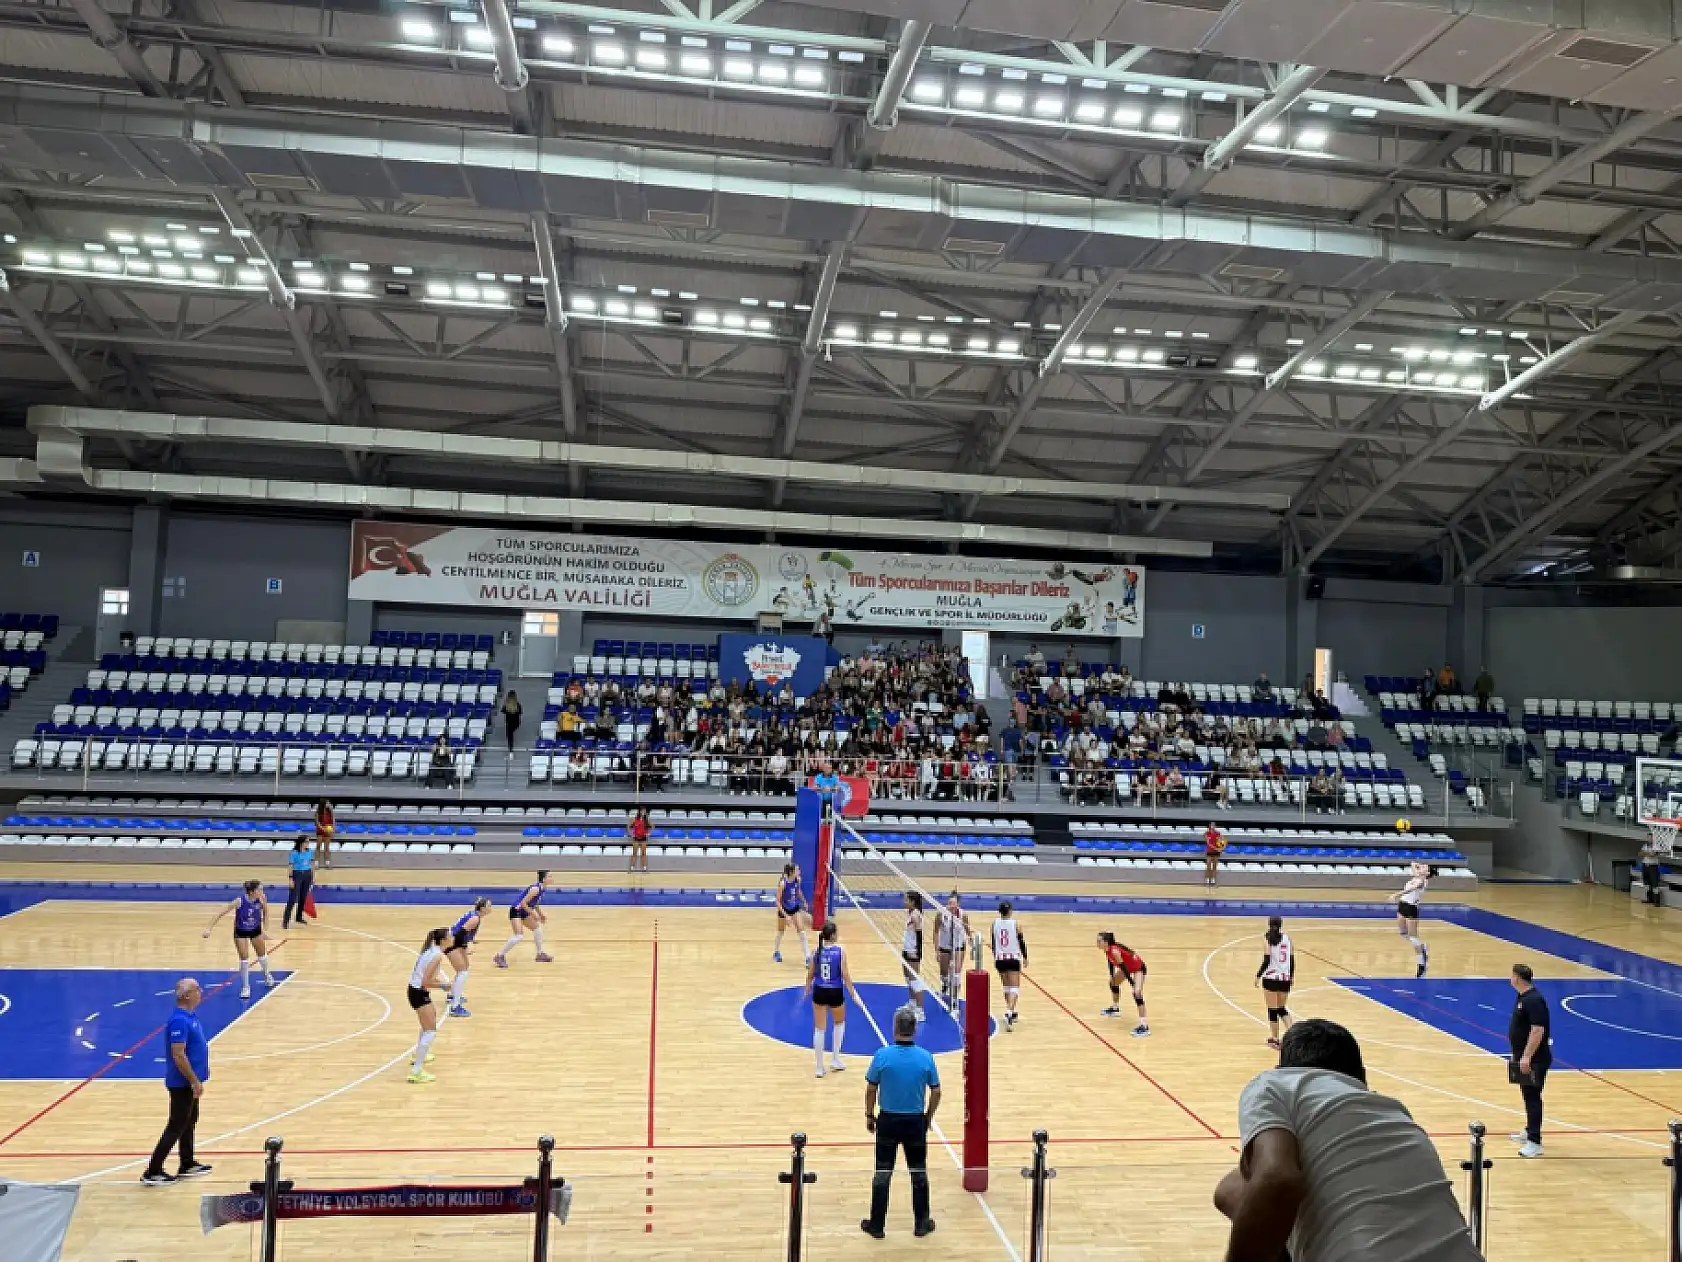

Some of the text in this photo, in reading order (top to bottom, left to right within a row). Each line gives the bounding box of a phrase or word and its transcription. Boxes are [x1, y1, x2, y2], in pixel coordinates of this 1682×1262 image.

[496, 538, 640, 556] TÜM SPORCULARIMIZA
[467, 552, 665, 573] HOŞGÖRÜNÜN HAKİM OLDUĞU
[441, 566, 532, 580] CENTİLMENCE
[563, 571, 635, 586] MÜSABAKA
[848, 572, 876, 587] Tüm
[480, 584, 651, 607] MUĞLA VALİLİĞİ
[937, 594, 982, 607] MUĞLA
[870, 606, 915, 617] GENÇLİK
[918, 608, 932, 617] VE
[935, 610, 963, 619] SPOR
[977, 610, 1048, 622] MÜDÜRLÜĞÜ
[1000, 928, 1009, 947] 8
[820, 964, 831, 980] 8
[336, 1194, 405, 1209] VOLEYBOL
[409, 1193, 445, 1208] SPOR
[448, 1190, 503, 1207] KULÜBÜ
